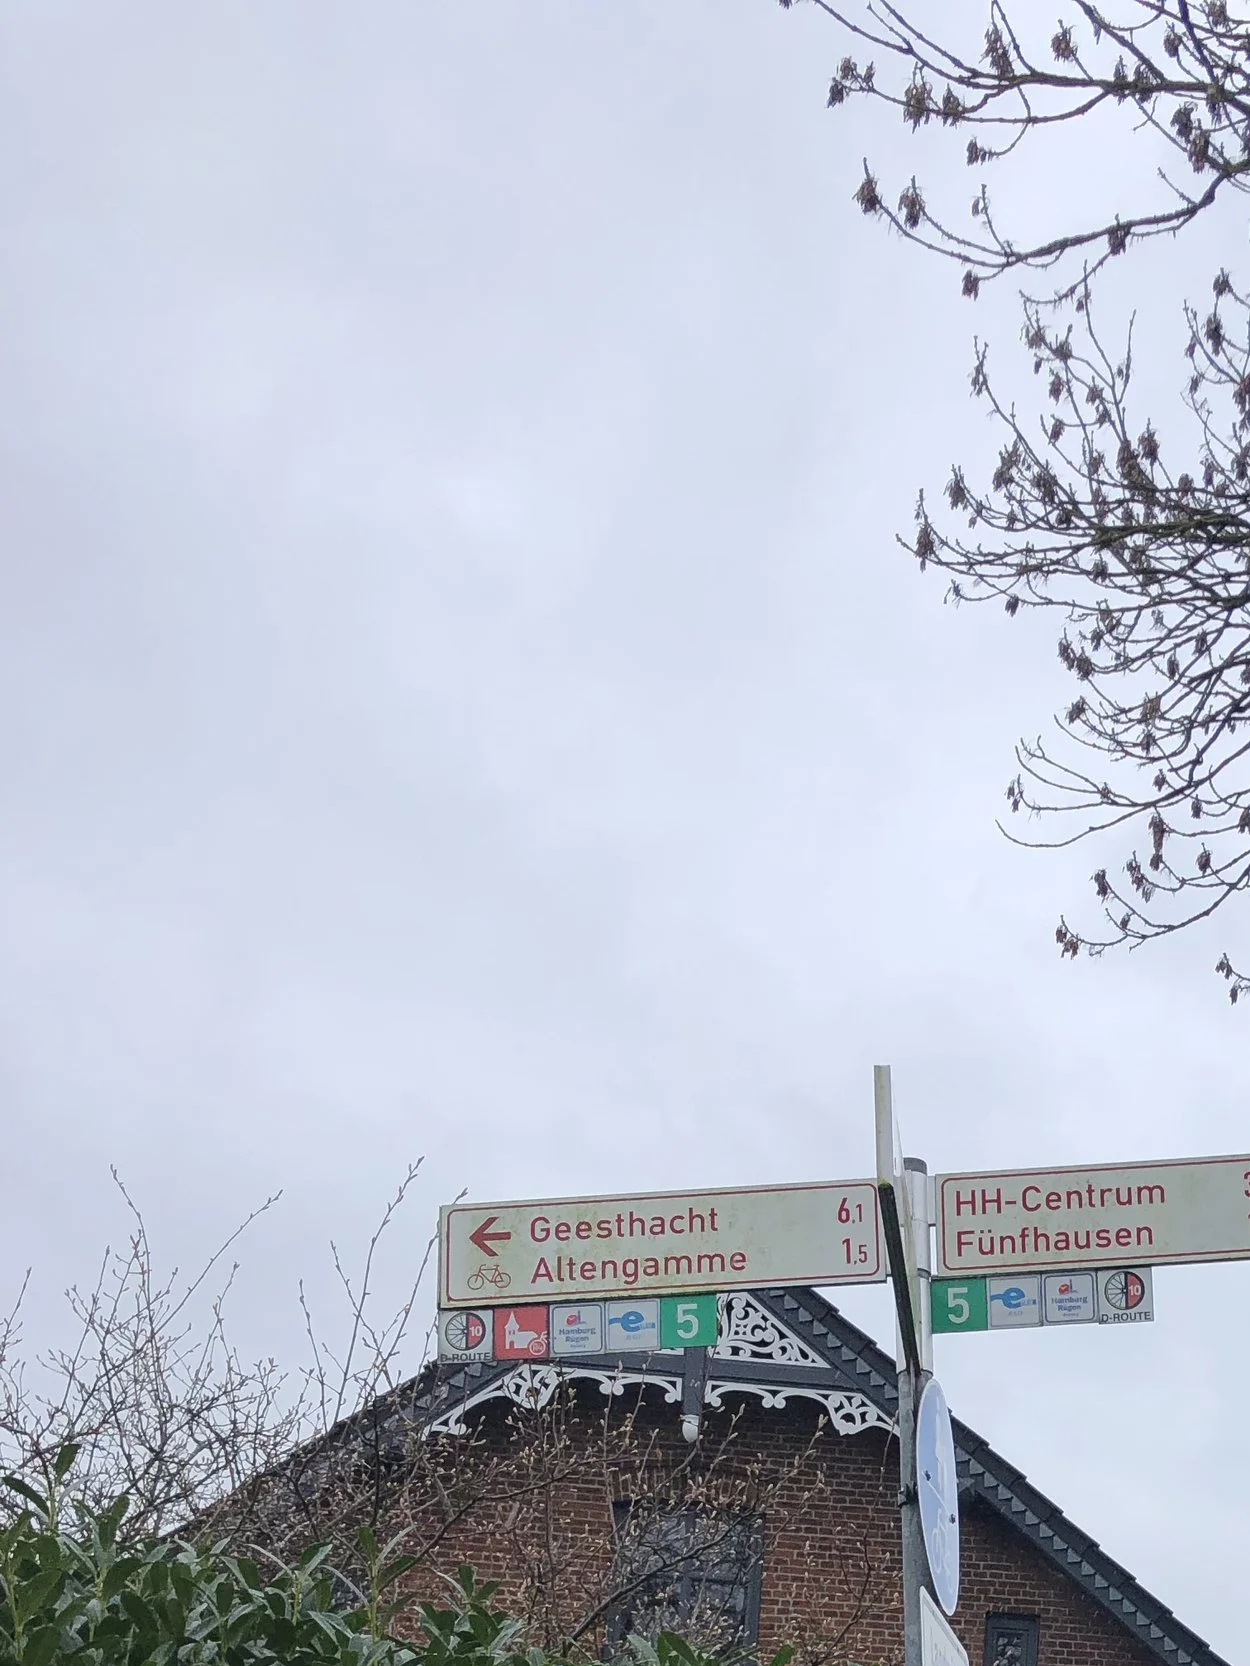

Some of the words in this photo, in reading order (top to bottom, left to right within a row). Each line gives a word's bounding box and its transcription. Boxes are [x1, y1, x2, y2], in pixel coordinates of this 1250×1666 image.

[956, 1184, 1166, 1217] HH-Centrum
[530, 1207, 718, 1243] Geesthacht
[837, 1197, 863, 1224] 6,1
[956, 1225, 1153, 1257] Fünfhausen
[530, 1251, 747, 1285] Altengamme
[842, 1238, 868, 1265] 1,5
[947, 1287, 970, 1324] 5
[1128, 1285, 1141, 1296] 10
[469, 1326, 483, 1337] 10
[559, 1326, 597, 1336] Hamburg
[676, 1303, 699, 1339] 5
[1101, 1311, 1152, 1323] D-ROUTE
[440, 1352, 491, 1363] D-ROUTE
